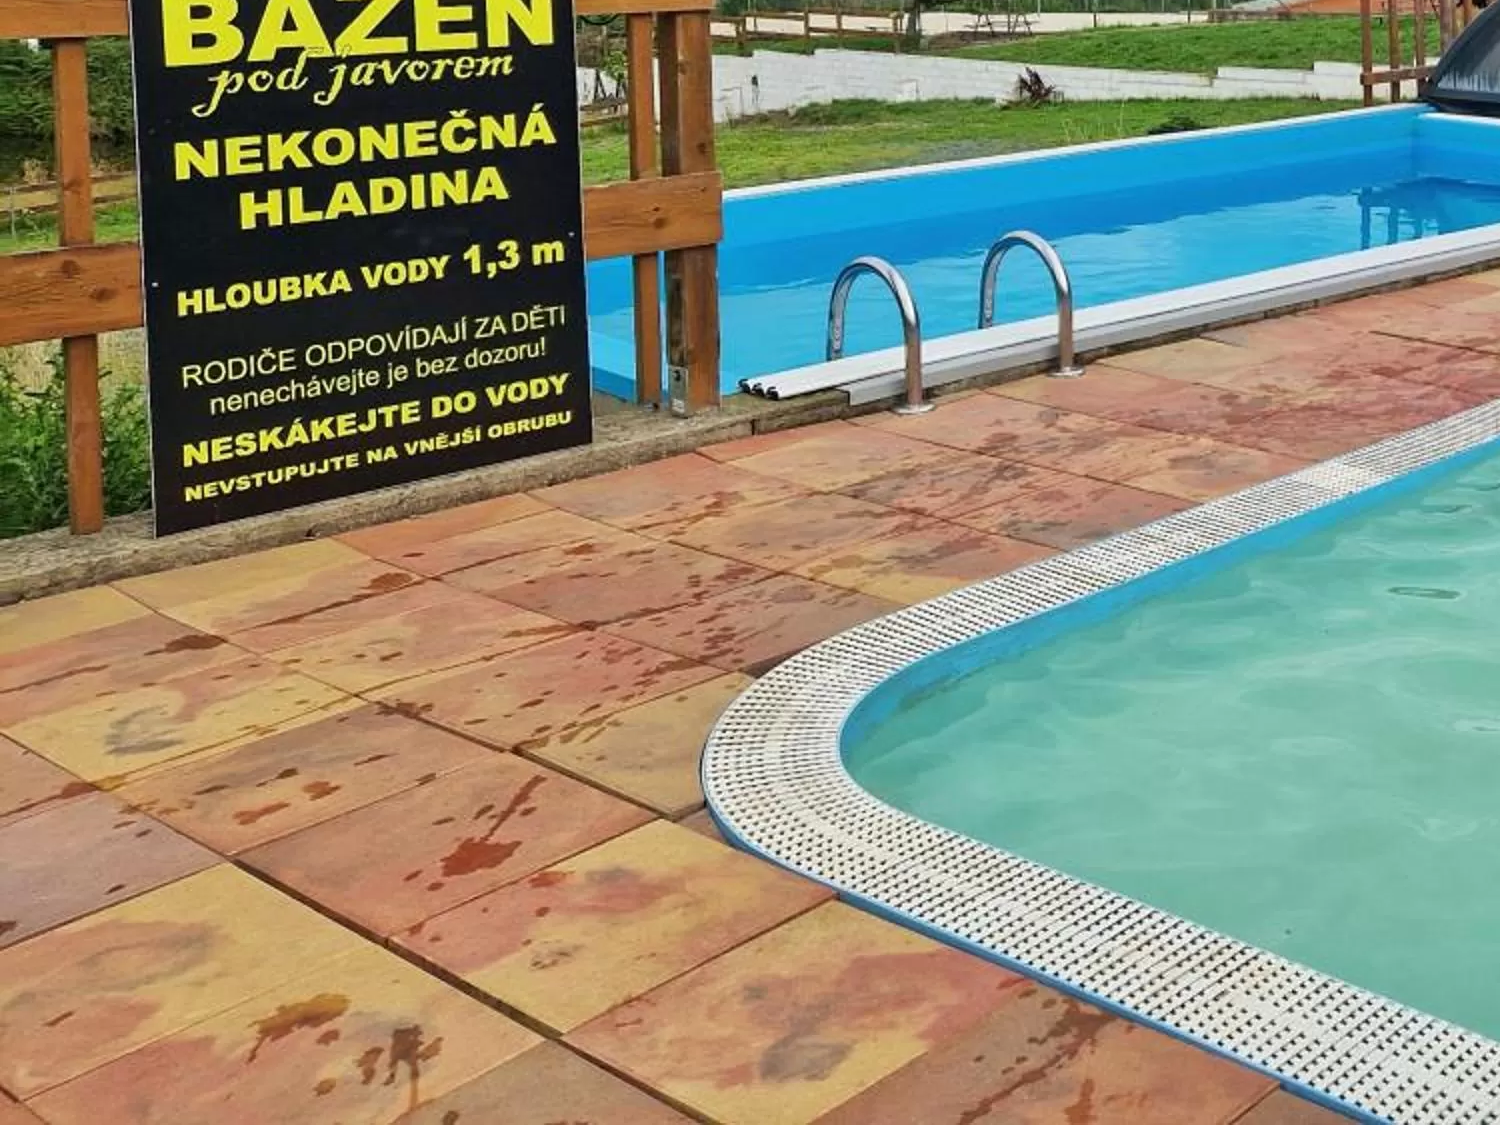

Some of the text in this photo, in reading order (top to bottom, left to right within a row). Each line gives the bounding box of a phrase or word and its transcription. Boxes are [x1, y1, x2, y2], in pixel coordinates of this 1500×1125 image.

[191, 43, 514, 118] pod javorem
[173, 103, 557, 181] NEKONEČNÁ
[239, 166, 509, 230] HLADINA
[177, 240, 566, 317] HLOUBKA VODY 1,3 m
[182, 305, 566, 388] RODIČE ODPOVÍDAJÍ ZA DĚTI
[210, 336, 547, 415] nenechávejte je bez dozoru!
[183, 373, 570, 468] NESKÁKEJTE DO VODY
[184, 410, 573, 502] NEVSTUPUJTE NA VNĚJŠÍ OBRUBU
